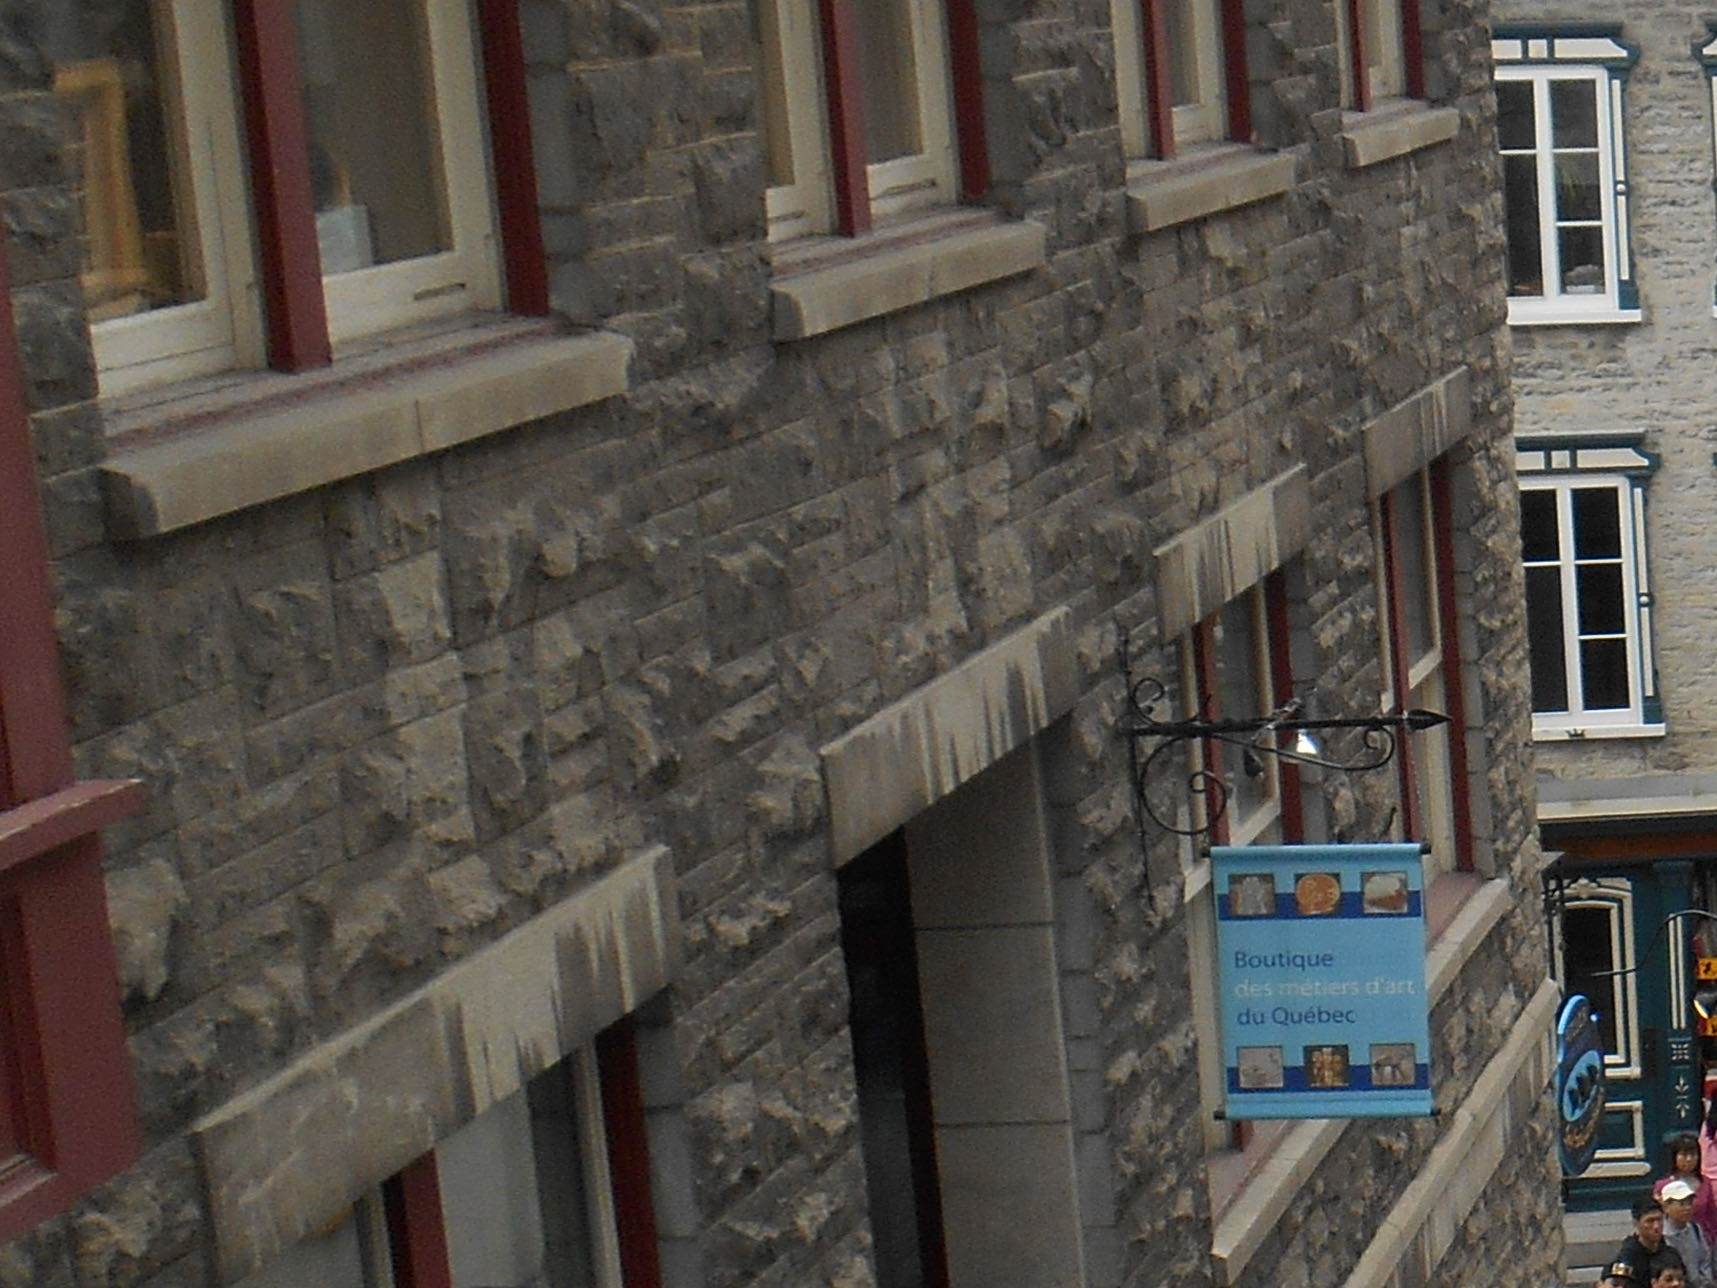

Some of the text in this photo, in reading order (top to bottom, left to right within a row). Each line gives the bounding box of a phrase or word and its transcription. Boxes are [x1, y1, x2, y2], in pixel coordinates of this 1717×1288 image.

[1234, 951, 1333, 971] Boutique
[1235, 976, 1416, 997] des métiers d'art
[1237, 1006, 1356, 1026] du Québec
